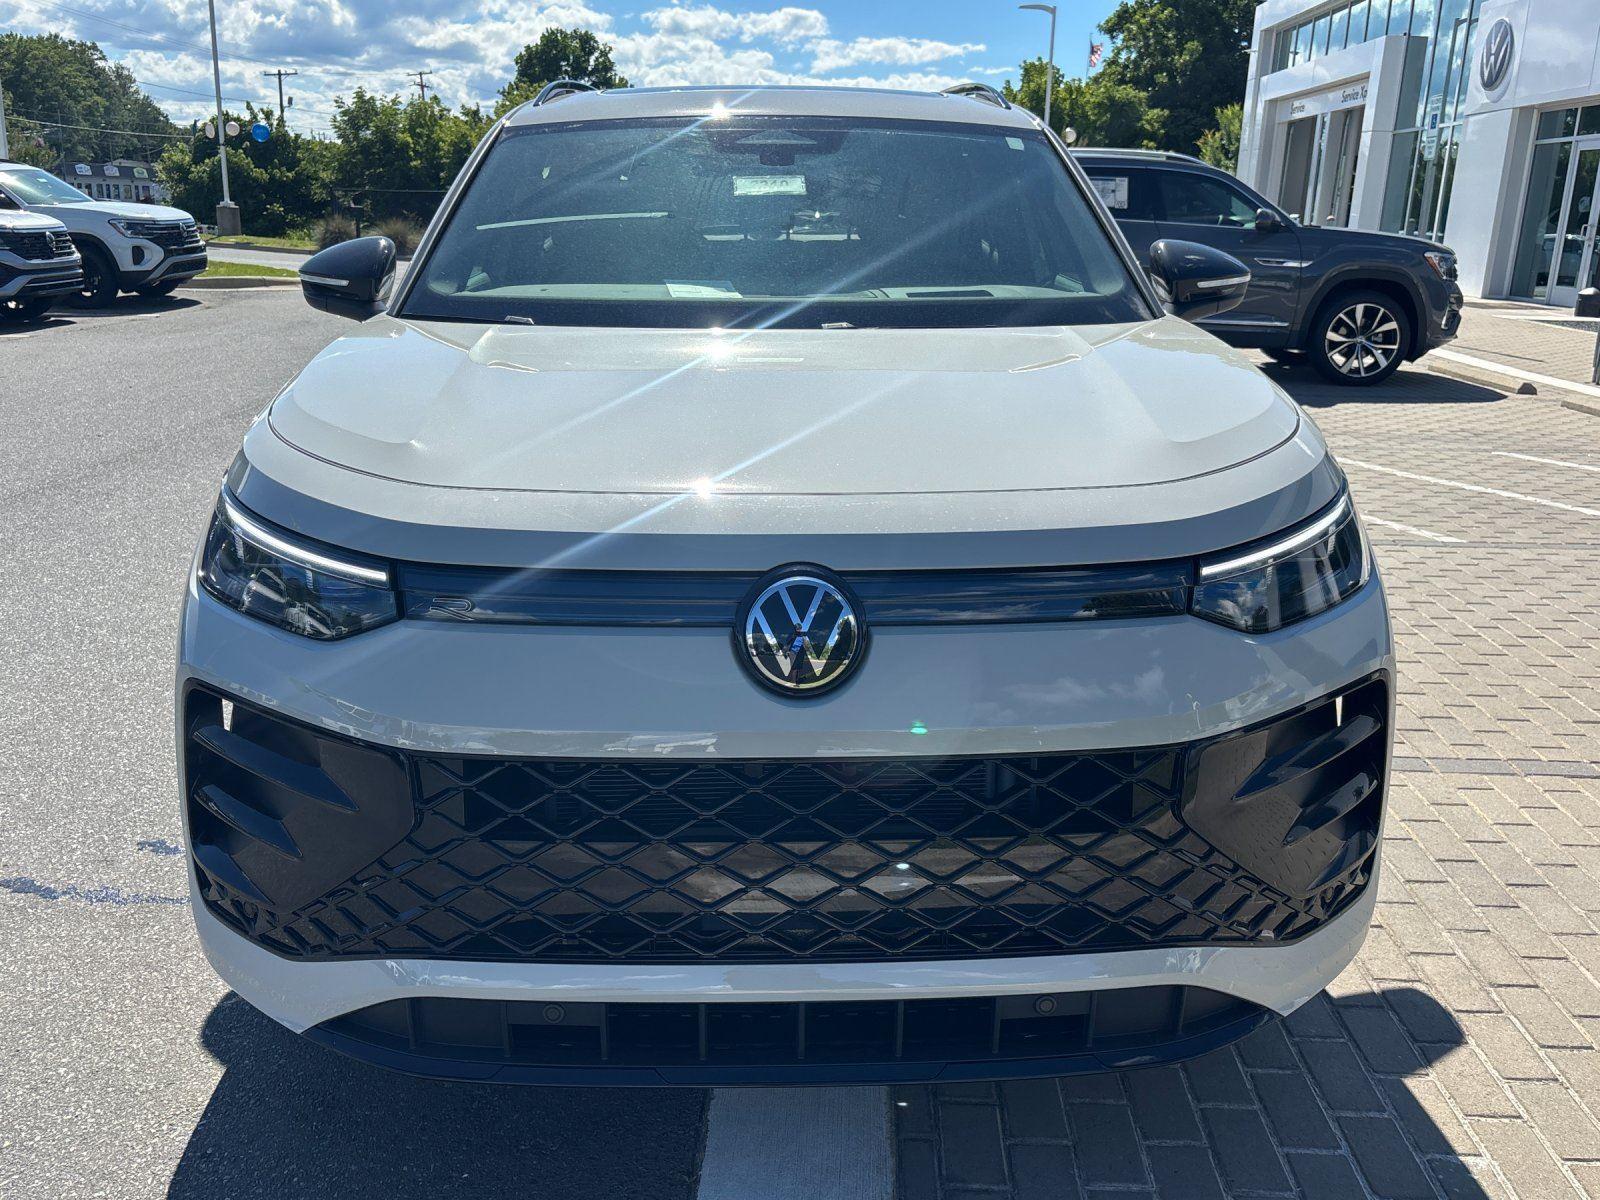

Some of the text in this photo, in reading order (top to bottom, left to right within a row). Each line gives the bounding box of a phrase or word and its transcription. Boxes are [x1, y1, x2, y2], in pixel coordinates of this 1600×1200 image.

[1341, 88, 1360, 103] Service
[1290, 101, 1305, 115] Service
[748, 578, 856, 686] VW
